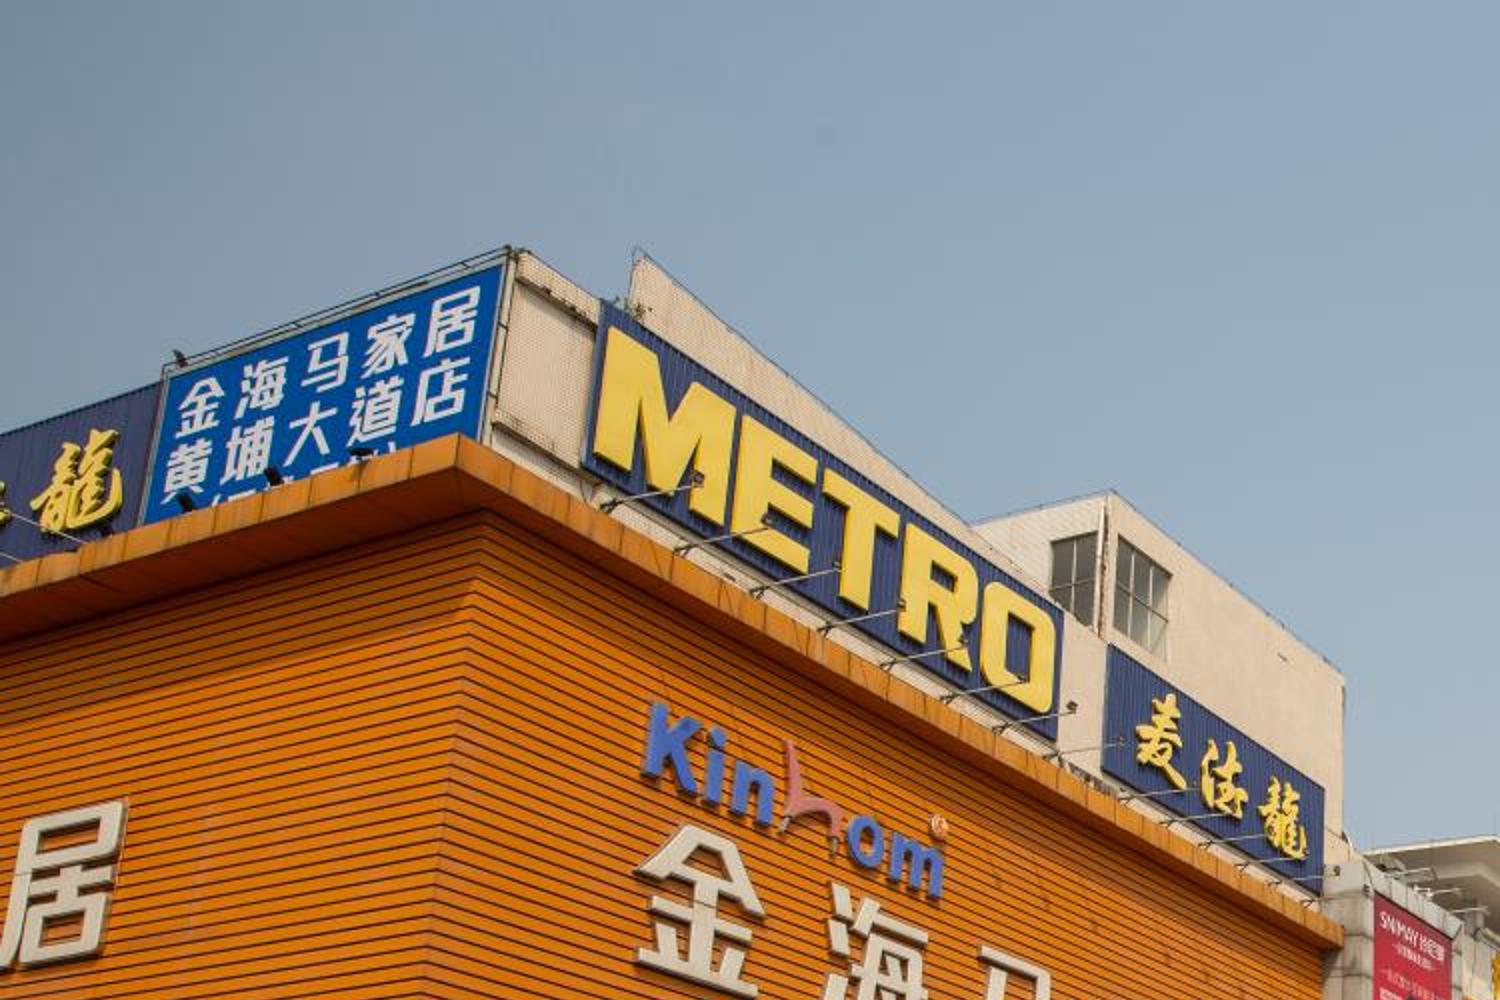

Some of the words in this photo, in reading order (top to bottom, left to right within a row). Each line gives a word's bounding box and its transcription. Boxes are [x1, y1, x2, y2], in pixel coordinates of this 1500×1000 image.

[162, 354, 472, 503] 黄埔大道店
[174, 284, 482, 439] 金海马家居
[0, 427, 122, 535] 龍
[591, 325, 1058, 715] METRO
[641, 701, 945, 900] Kinhom
[0, 799, 127, 970] 居
